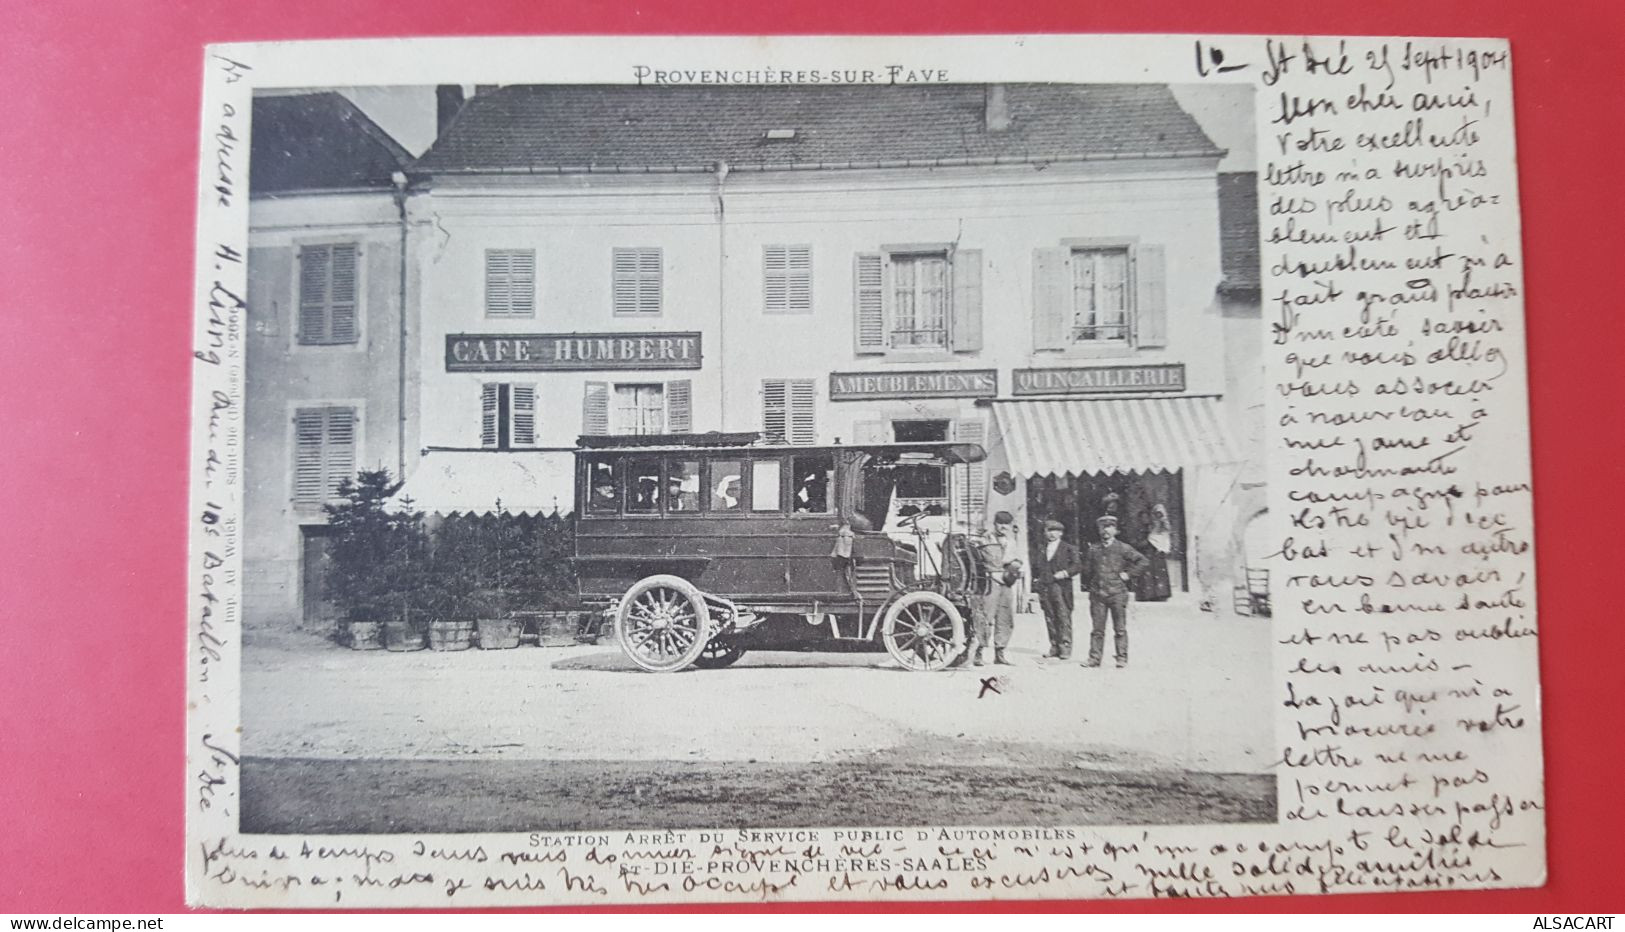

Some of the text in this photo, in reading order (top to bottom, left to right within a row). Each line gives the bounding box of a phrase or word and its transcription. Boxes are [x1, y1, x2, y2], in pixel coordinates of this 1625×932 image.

[1272, 91, 1337, 124] Mon
[1264, 163, 1325, 187] lettre
[1393, 154, 1488, 200] surpris
[1270, 195, 1317, 216] des
[1326, 188, 1394, 225] plus
[1273, 280, 1343, 316] fait
[1446, 272, 1519, 312] plaisir
[453, 338, 695, 362] CAFE HUMBERT
[1285, 351, 1332, 380] que
[832, 373, 996, 394] AMEUBLEMENTS
[1018, 369, 1182, 388] QUINCAILLERIE
[1276, 376, 1494, 398] vous associer
[1308, 406, 1455, 426] nouveau
[1443, 422, 1480, 443] et
[1289, 447, 1466, 479] charmante
[1475, 481, 1532, 508] pour
[1350, 543, 1383, 558] et
[1461, 528, 1529, 560] autre
[1287, 575, 1375, 588] vous
[1301, 599, 1347, 614] en
[1279, 628, 1322, 646] et
[1328, 632, 1369, 645] ne
[1381, 628, 1442, 652] pas
[1359, 652, 1440, 674] amis
[1457, 703, 1525, 732] votre
[1277, 746, 1469, 768] lettre ne me
[1296, 769, 1490, 803] permet pas
[1337, 797, 1447, 818] laisser
[529, 827, 1076, 847] STATION ARRÊT DU SERVICE PUBLIC D'AUTOMOBILES
[483, 873, 547, 891] suis
[827, 872, 865, 892] et
[1135, 862, 1212, 883] mille
